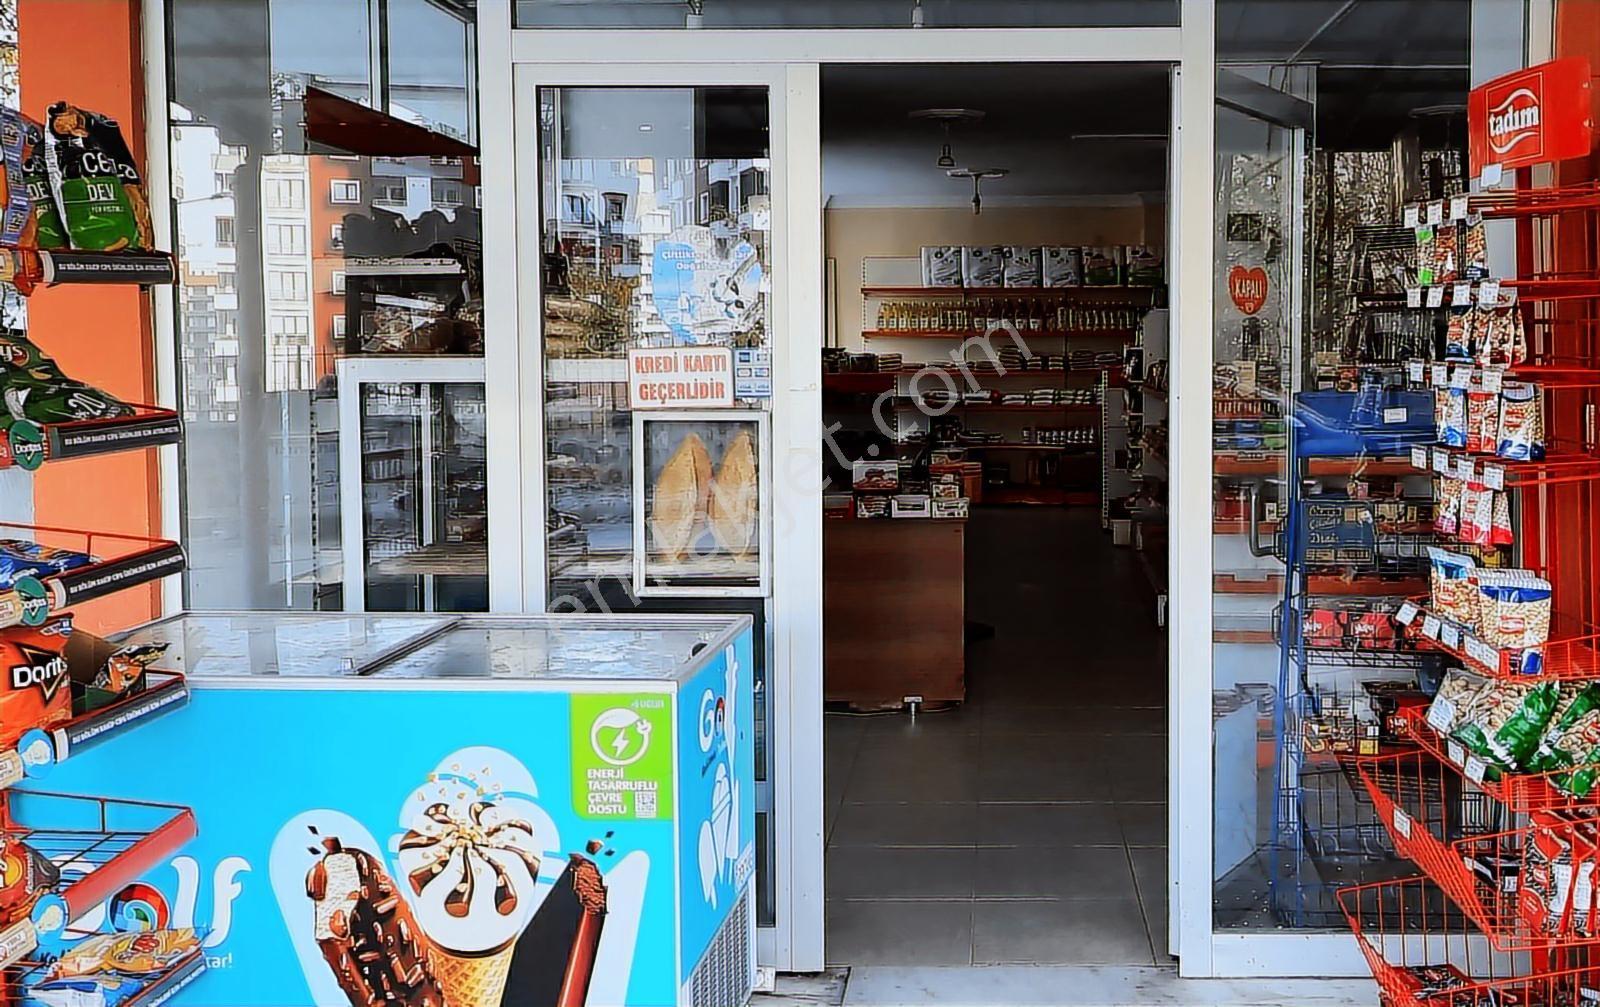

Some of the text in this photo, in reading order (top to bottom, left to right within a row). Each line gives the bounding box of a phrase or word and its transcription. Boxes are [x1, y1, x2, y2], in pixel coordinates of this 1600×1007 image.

[1489, 105, 1540, 137] tadım
[87, 183, 115, 201] DEV
[1235, 276, 1262, 300] KAPALI
[635, 351, 678, 374] KREDİ
[683, 354, 727, 373] KARTI
[639, 377, 725, 405] GEÇERLİDİR
[587, 766, 624, 779] ENERJİ
[588, 780, 658, 791] TASARRUFLU
[588, 792, 623, 804] ÇEVRE
[588, 804, 627, 815] DOSTU
